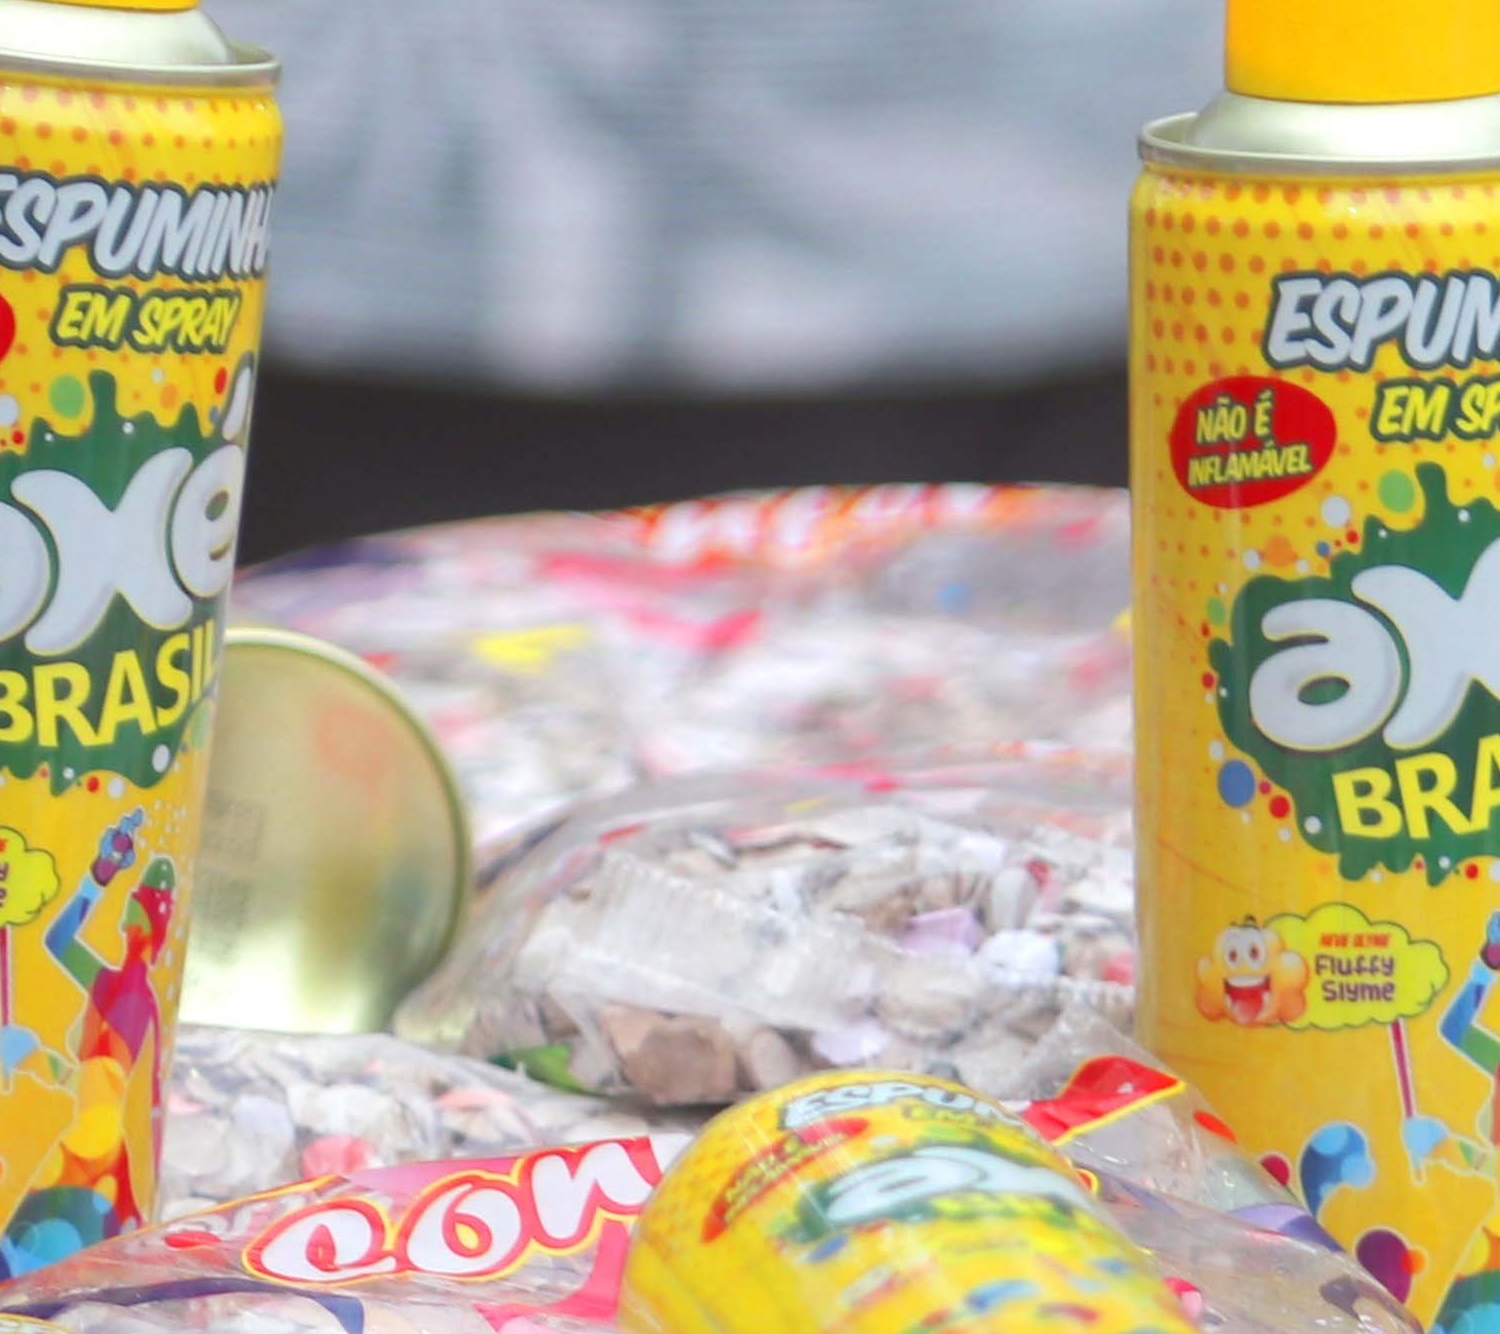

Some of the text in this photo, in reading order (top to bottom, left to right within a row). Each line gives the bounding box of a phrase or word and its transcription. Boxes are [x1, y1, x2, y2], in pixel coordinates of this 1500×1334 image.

[54, 288, 240, 349] EM SPRAY
[1196, 388, 1274, 445] NÃO É
[1376, 384, 1453, 436] EM
[1187, 439, 1313, 487] INFLAMÁVEL
[1314, 952, 1395, 978] Fluffy
[1321, 979, 1395, 1003] Slyme
